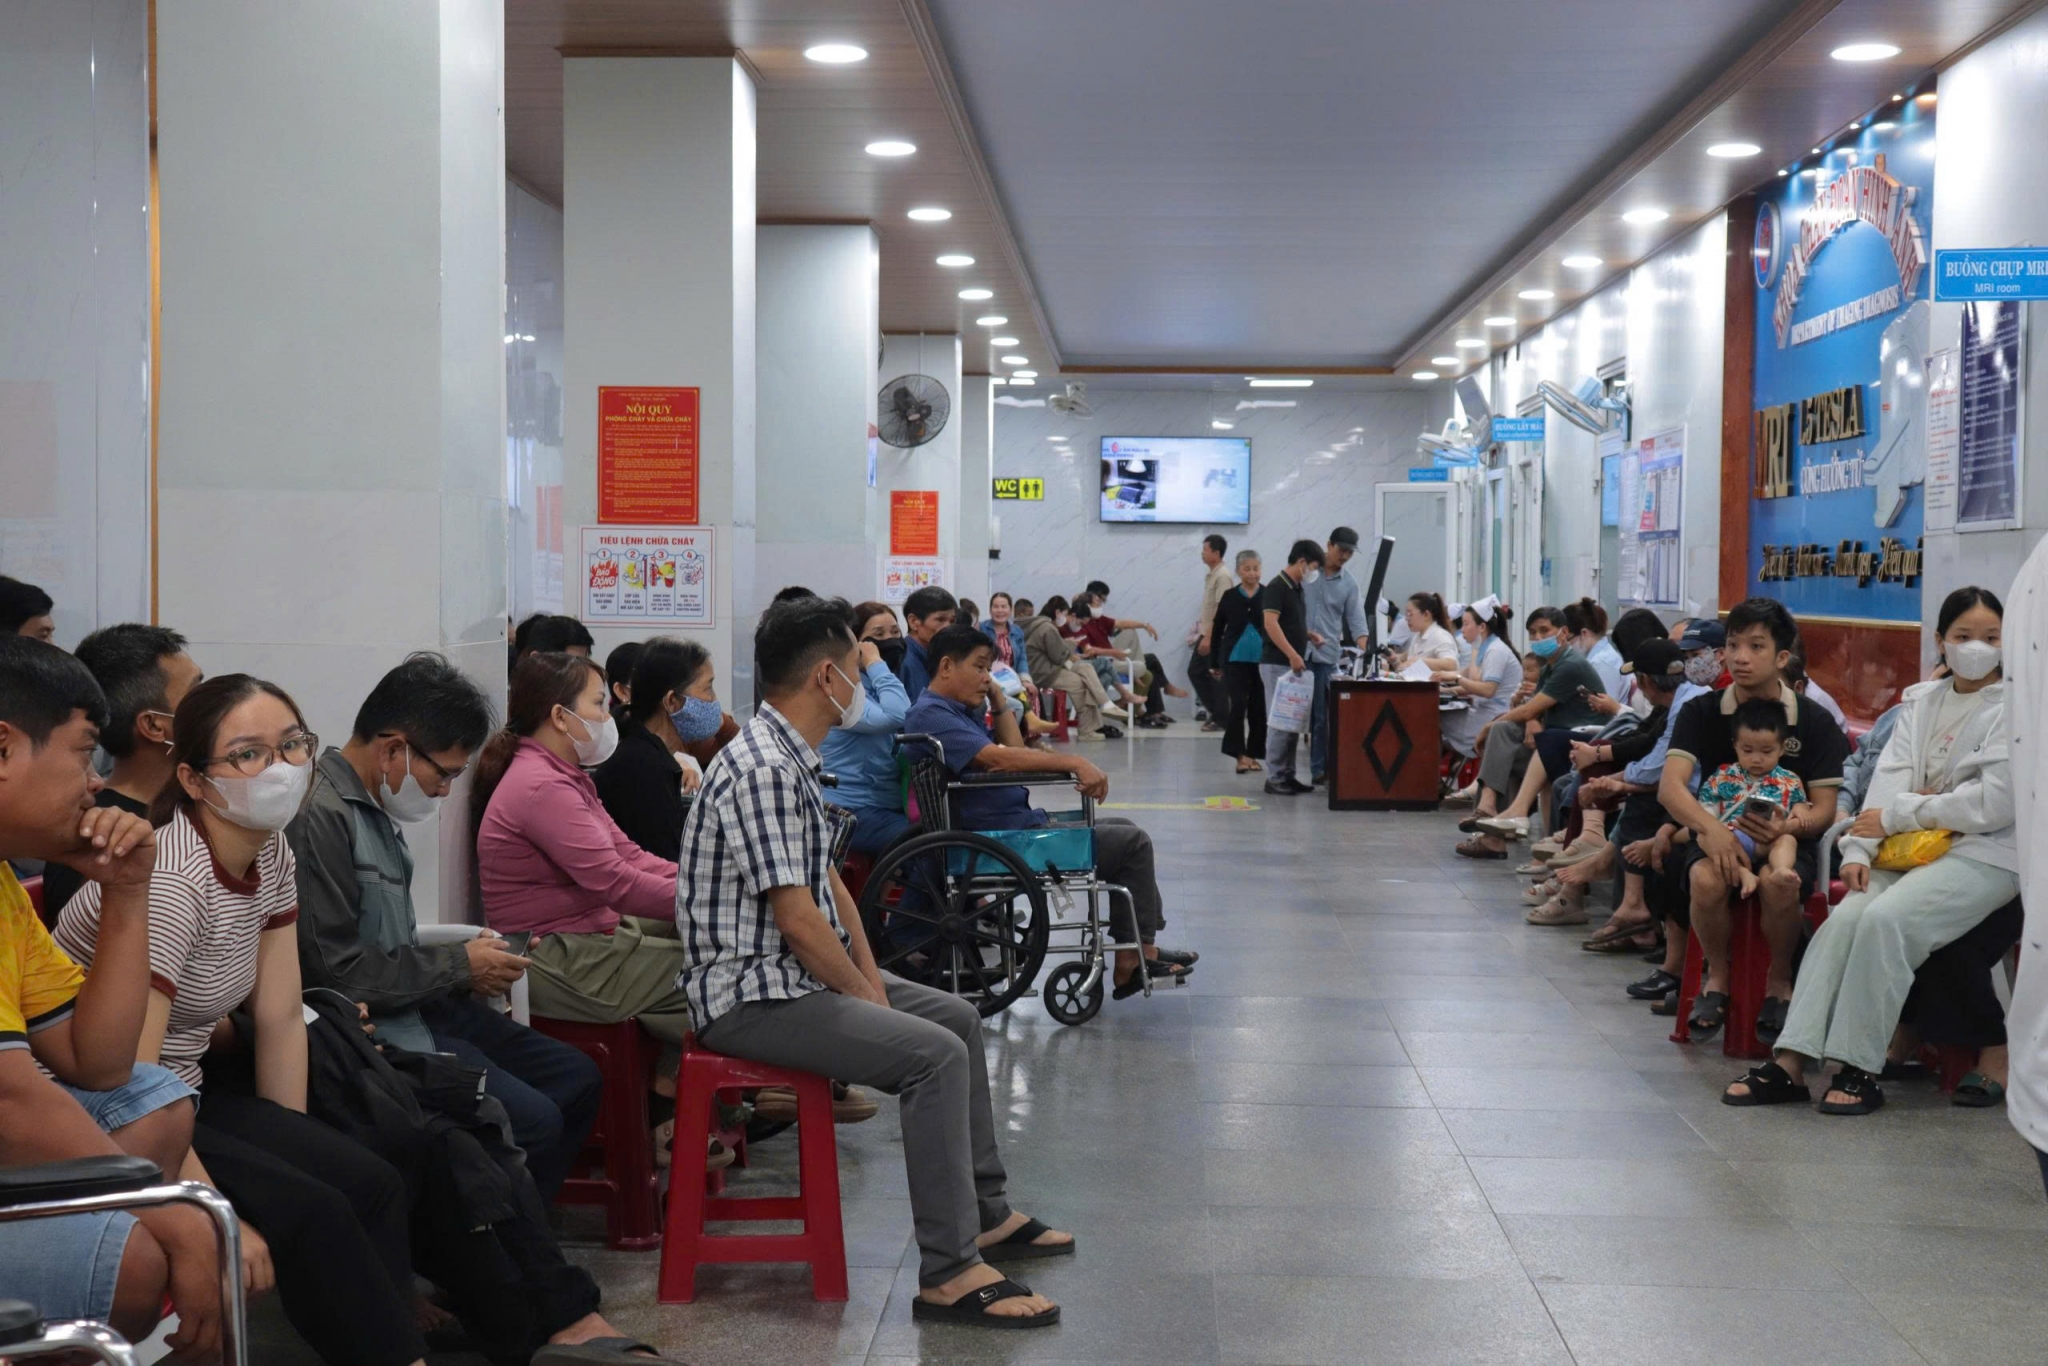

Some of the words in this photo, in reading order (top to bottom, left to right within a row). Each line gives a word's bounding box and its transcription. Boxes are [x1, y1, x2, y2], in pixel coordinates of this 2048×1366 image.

[1945, 254, 1987, 277] BUỒNG
[1990, 261, 2024, 279] CHỤP
[1975, 283, 1994, 293] MRI
[1997, 284, 2021, 293] room
[626, 402, 646, 416] NỘI
[648, 405, 672, 416] QUY
[1814, 385, 1859, 442] TESLA
[1754, 403, 1794, 499] MRI
[995, 479, 1017, 491] WC
[621, 536, 642, 546] LỆNH
[671, 537, 695, 546] CHÁY
[686, 551, 692, 559] 4
[593, 577, 614, 588] ĐỘNG
